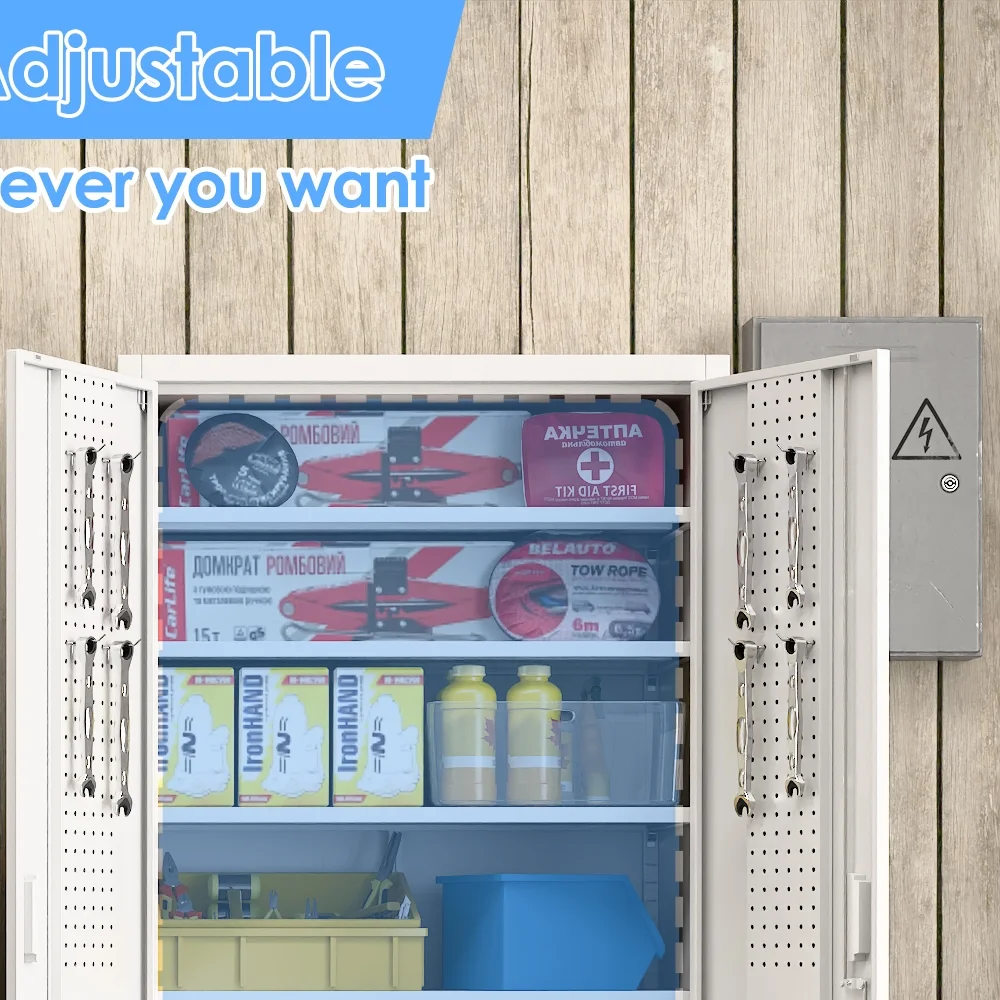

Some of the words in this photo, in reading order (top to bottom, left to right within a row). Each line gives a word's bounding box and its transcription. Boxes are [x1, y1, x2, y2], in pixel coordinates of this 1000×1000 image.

[192, 555, 260, 579] ДОМКРАТ
[266, 551, 346, 576] РОМБОВИЙ
[527, 542, 616, 555] BELAUTO
[571, 564, 604, 577] TOW
[607, 565, 648, 578] ROPE
[164, 566, 178, 640] CarLife
[242, 675, 264, 772] IronHAND
[337, 675, 359, 772] IronHAND
